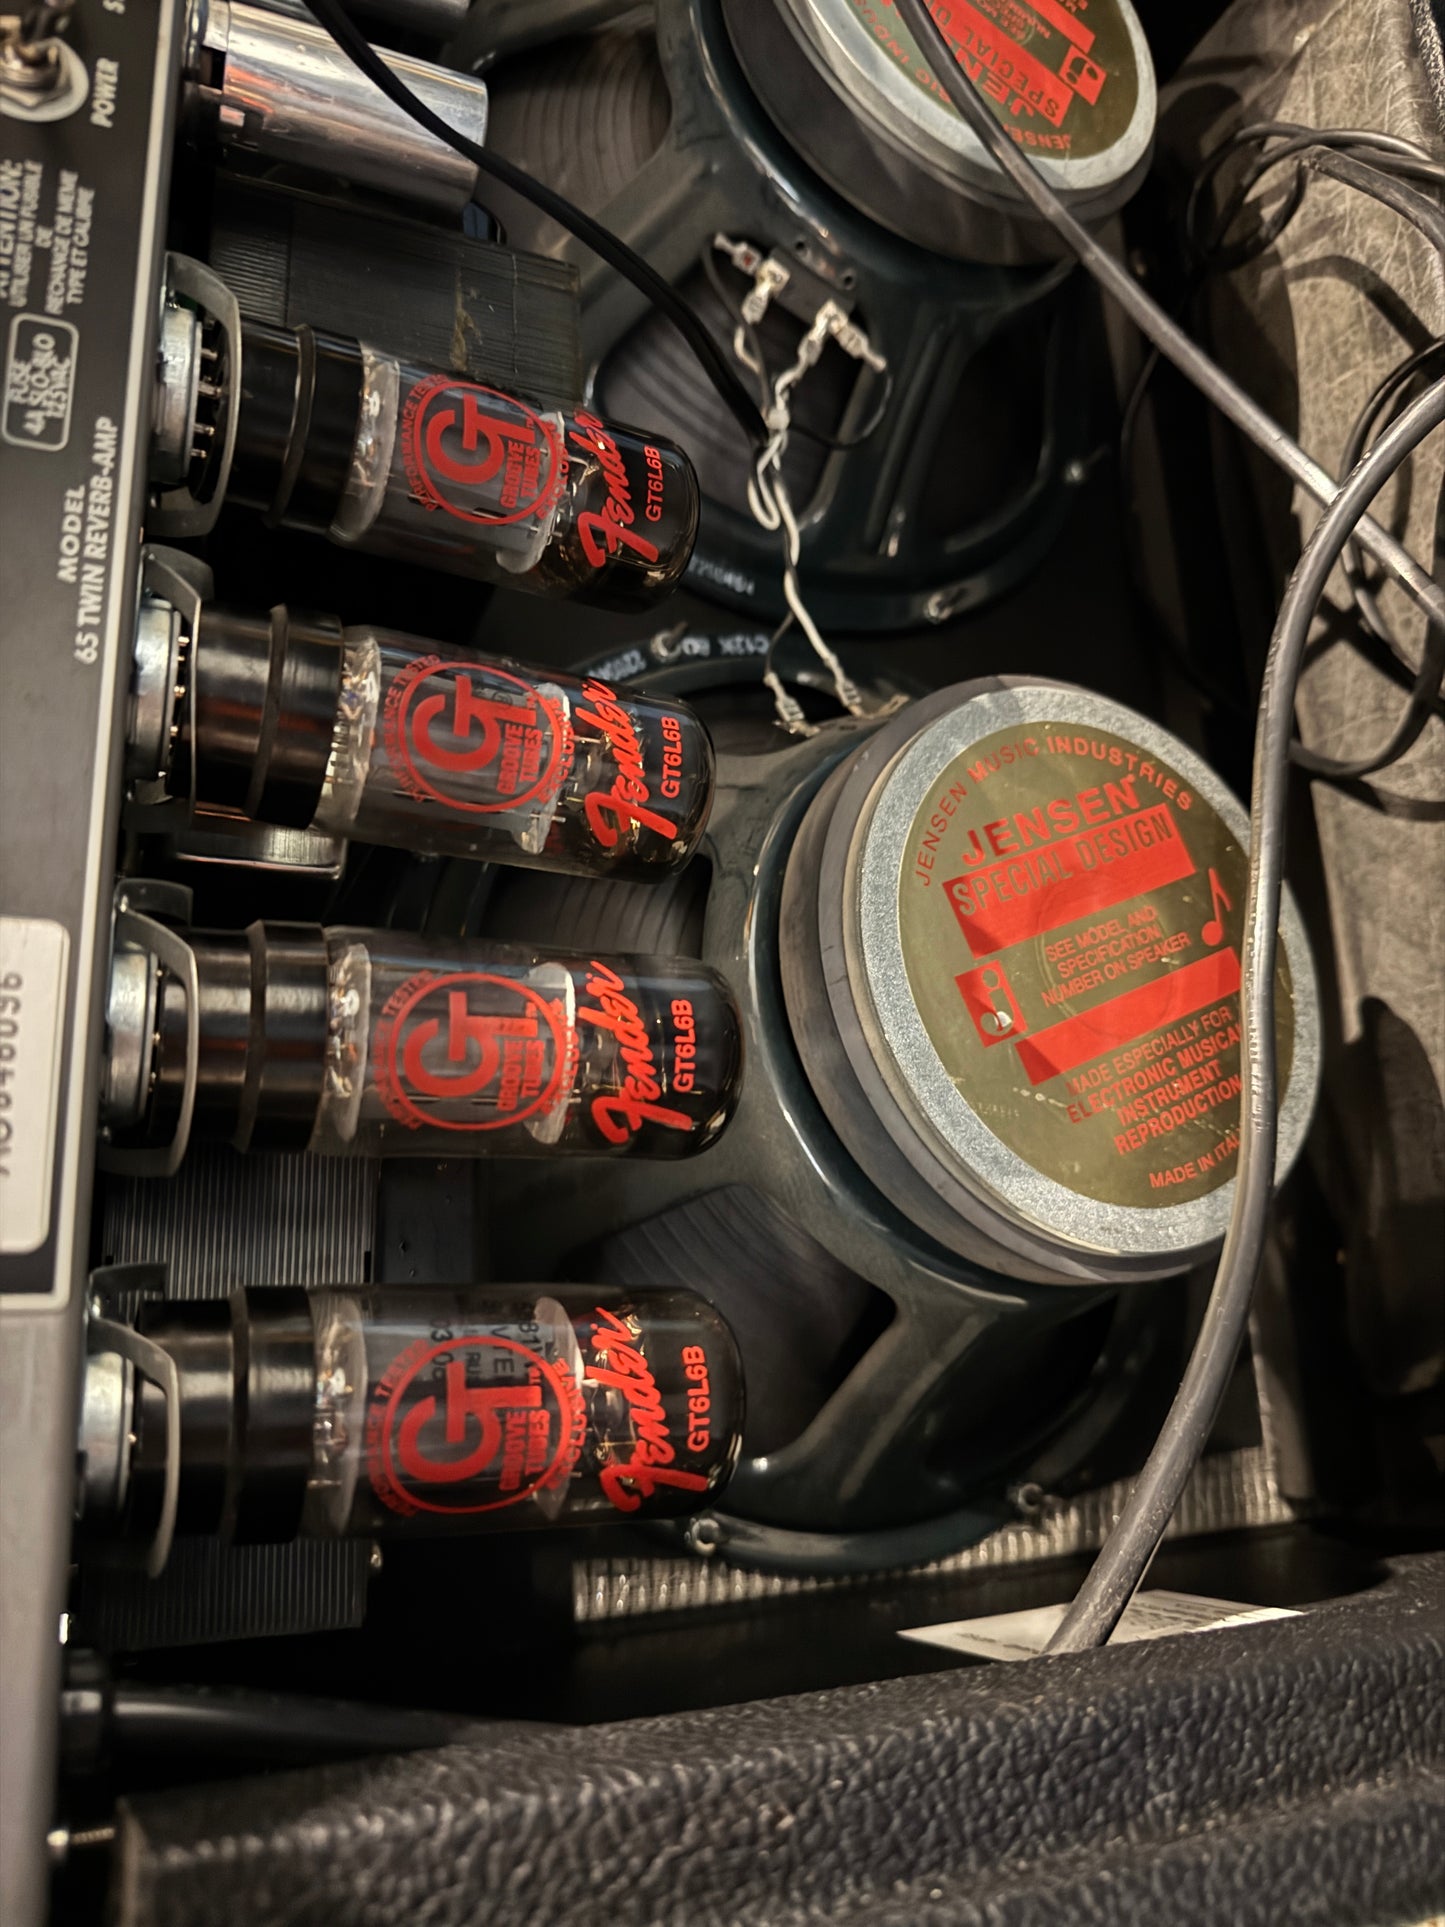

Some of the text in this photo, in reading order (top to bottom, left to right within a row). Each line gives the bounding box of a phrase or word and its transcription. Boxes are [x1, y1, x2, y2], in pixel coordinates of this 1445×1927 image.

[92, 58, 119, 128] POWER
[964, 26, 1060, 118] SPECIAL
[1002, 123, 1071, 151] JENSE
[84, 416, 118, 559] REVERB-AMP
[401, 399, 439, 512] PERFORMANCE
[500, 440, 524, 508] GROOVE
[520, 446, 541, 498] TUBES
[569, 410, 658, 567] Fender
[644, 446, 663, 522] GT6L6B
[57, 485, 85, 583] MODEL
[78, 563, 105, 626] TWIN
[496, 723, 523, 795] GROOVE
[518, 729, 542, 783] TUBES
[575, 679, 678, 847] Fender
[661, 717, 682, 798] GT6L6B
[915, 736, 1193, 887] JENSEN MUSIC INDUSTRIES
[962, 776, 1140, 866] JENSEN
[952, 811, 1174, 916] SPECIAL DESIGN
[1041, 932, 1192, 1008] NUMBER ON SPEAKER
[1045, 906, 1158, 961] SEE MODEL AND
[1057, 926, 1163, 978] SPECIFICATION
[496, 1041, 523, 1112] GROOVE
[521, 1040, 545, 1097] TUBES
[578, 961, 693, 1143] Fender
[671, 1000, 696, 1092] GT6L6B
[1065, 1005, 1232, 1095] MADE ESPECIALLY FOR
[1066, 1022, 1241, 1124] ELECTRONIC MUSICA
[1114, 1074, 1243, 1155] REPRODUCTION
[1116, 1059, 1222, 1127] INSTRUMENT
[1150, 1128, 1241, 1188] MADE IN ITAL
[585, 1307, 708, 1512] Fender
[682, 1345, 710, 1452] GT6L6B
[498, 1411, 526, 1490] GROOVE
[524, 1410, 550, 1476] TUBES
